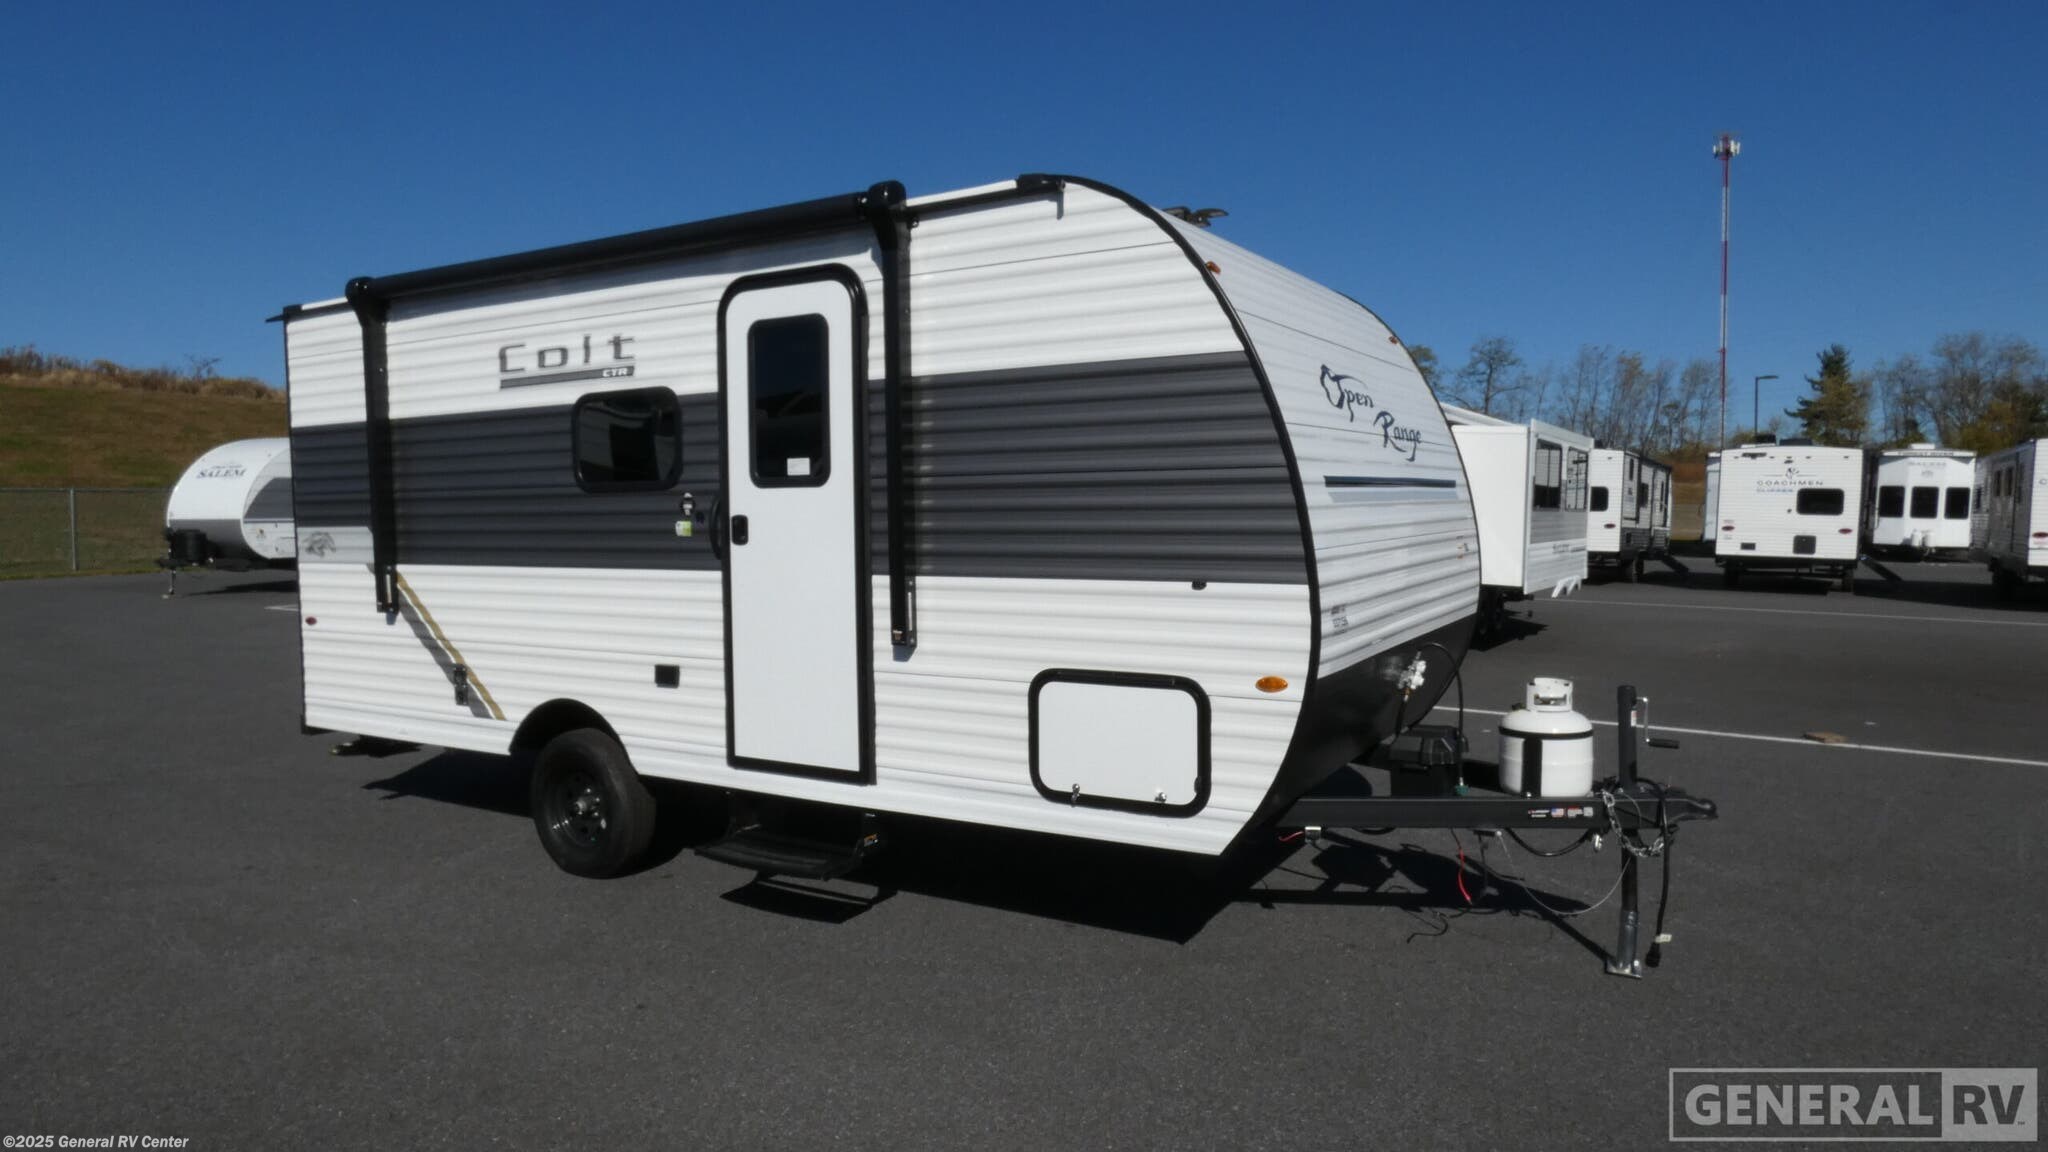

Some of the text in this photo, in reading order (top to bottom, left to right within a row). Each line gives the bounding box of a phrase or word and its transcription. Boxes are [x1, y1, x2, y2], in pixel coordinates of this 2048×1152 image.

[499, 335, 635, 373] Colt
[1320, 364, 1422, 463] Open Range
[196, 469, 247, 479] SALEM
